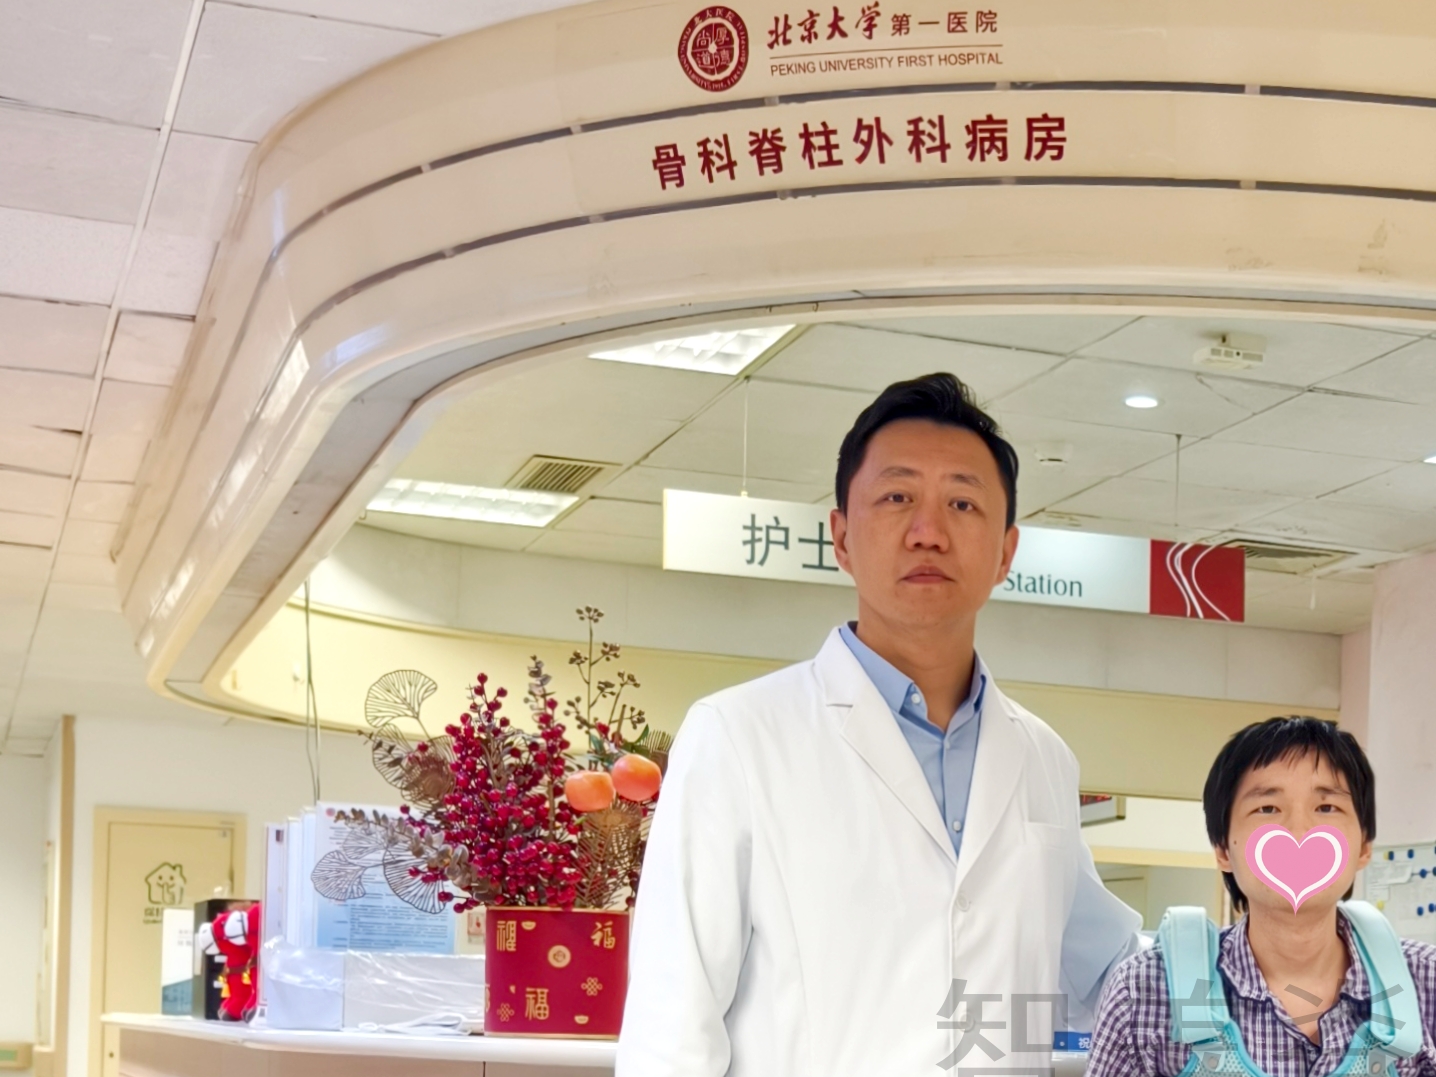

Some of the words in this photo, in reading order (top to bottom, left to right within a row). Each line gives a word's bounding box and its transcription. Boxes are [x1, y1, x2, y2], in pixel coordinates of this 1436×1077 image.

[767, 1, 998, 50] 北京大学第一医院
[770, 61, 817, 77] PEKING
[819, 56, 894, 73] UNIVERSITY
[897, 54, 935, 68] FIRST
[938, 52, 1004, 67] HOSPITAL
[652, 113, 1067, 191] 骨科脊柱外科病房
[1003, 570, 1083, 598] Station
